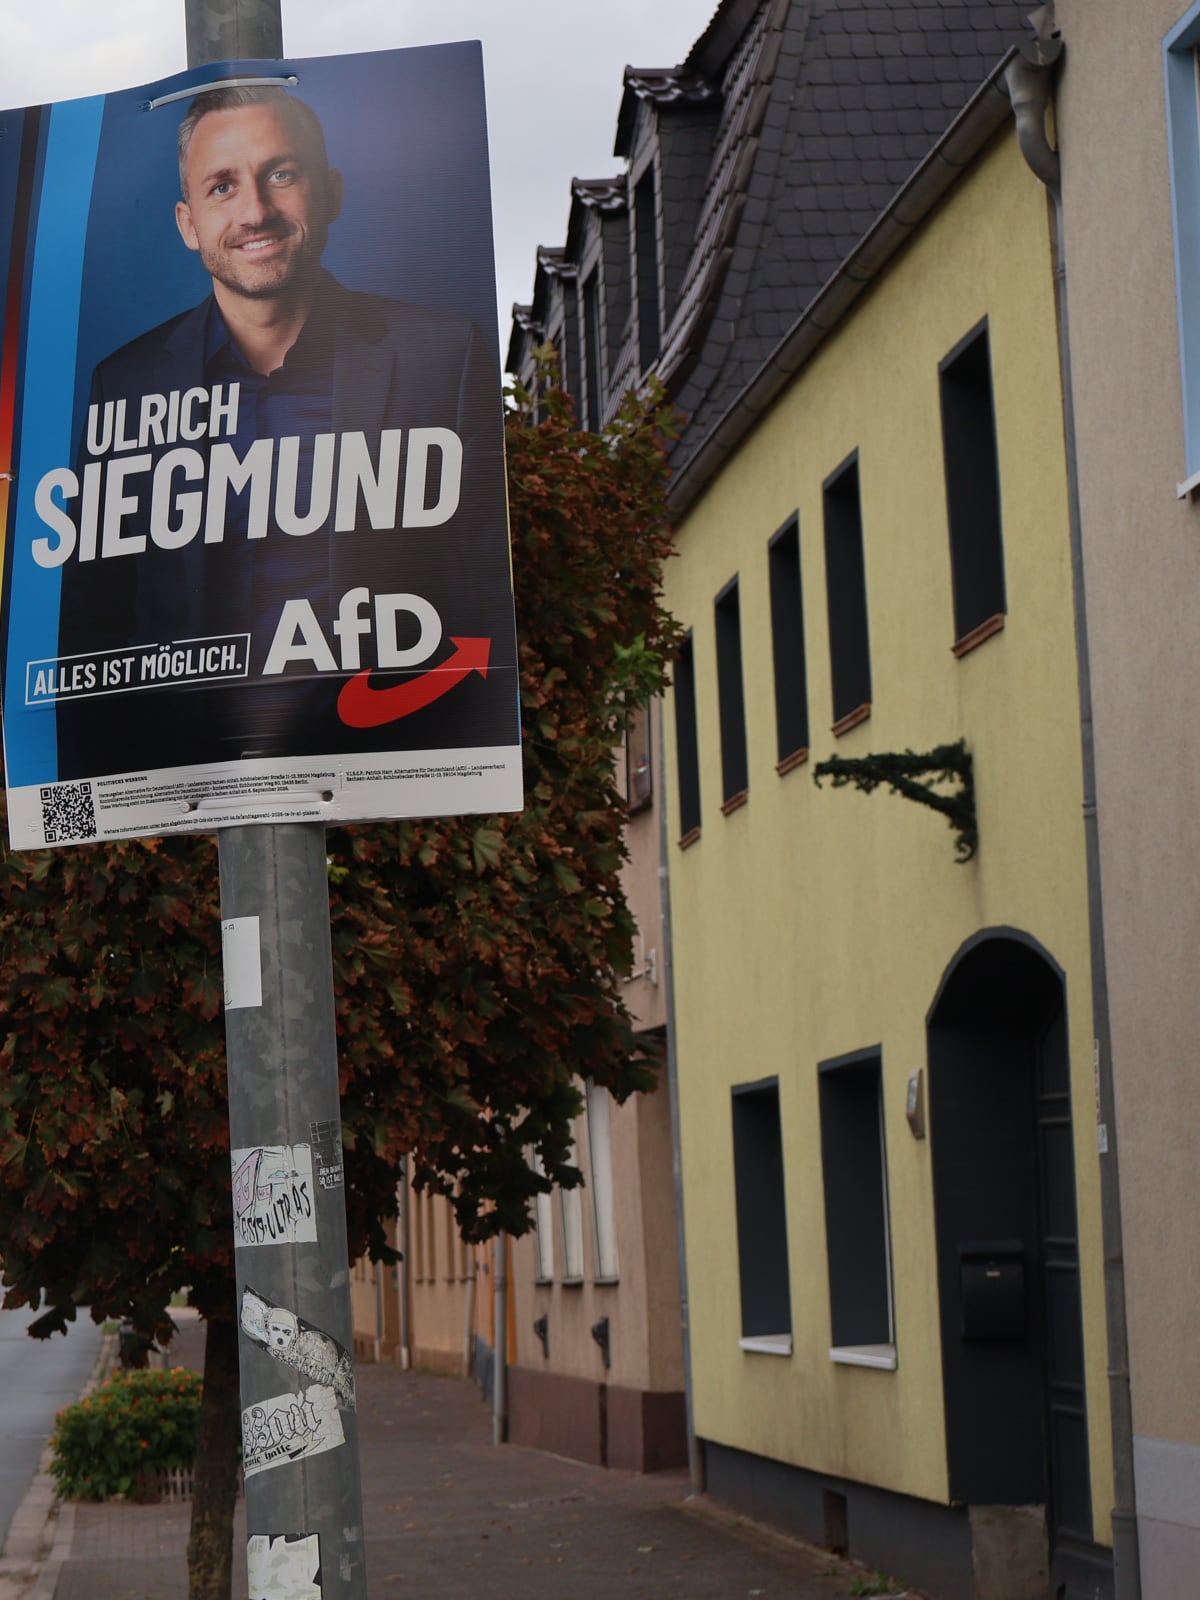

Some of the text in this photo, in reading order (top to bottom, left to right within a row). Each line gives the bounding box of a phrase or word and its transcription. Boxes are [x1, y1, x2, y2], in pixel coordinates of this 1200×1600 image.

[87, 382, 240, 456] ULRICH
[31, 426, 463, 569] SIEGMUND
[33, 644, 243, 696] ALLES IST MÖGLICH.
[262, 587, 443, 676] AfD
